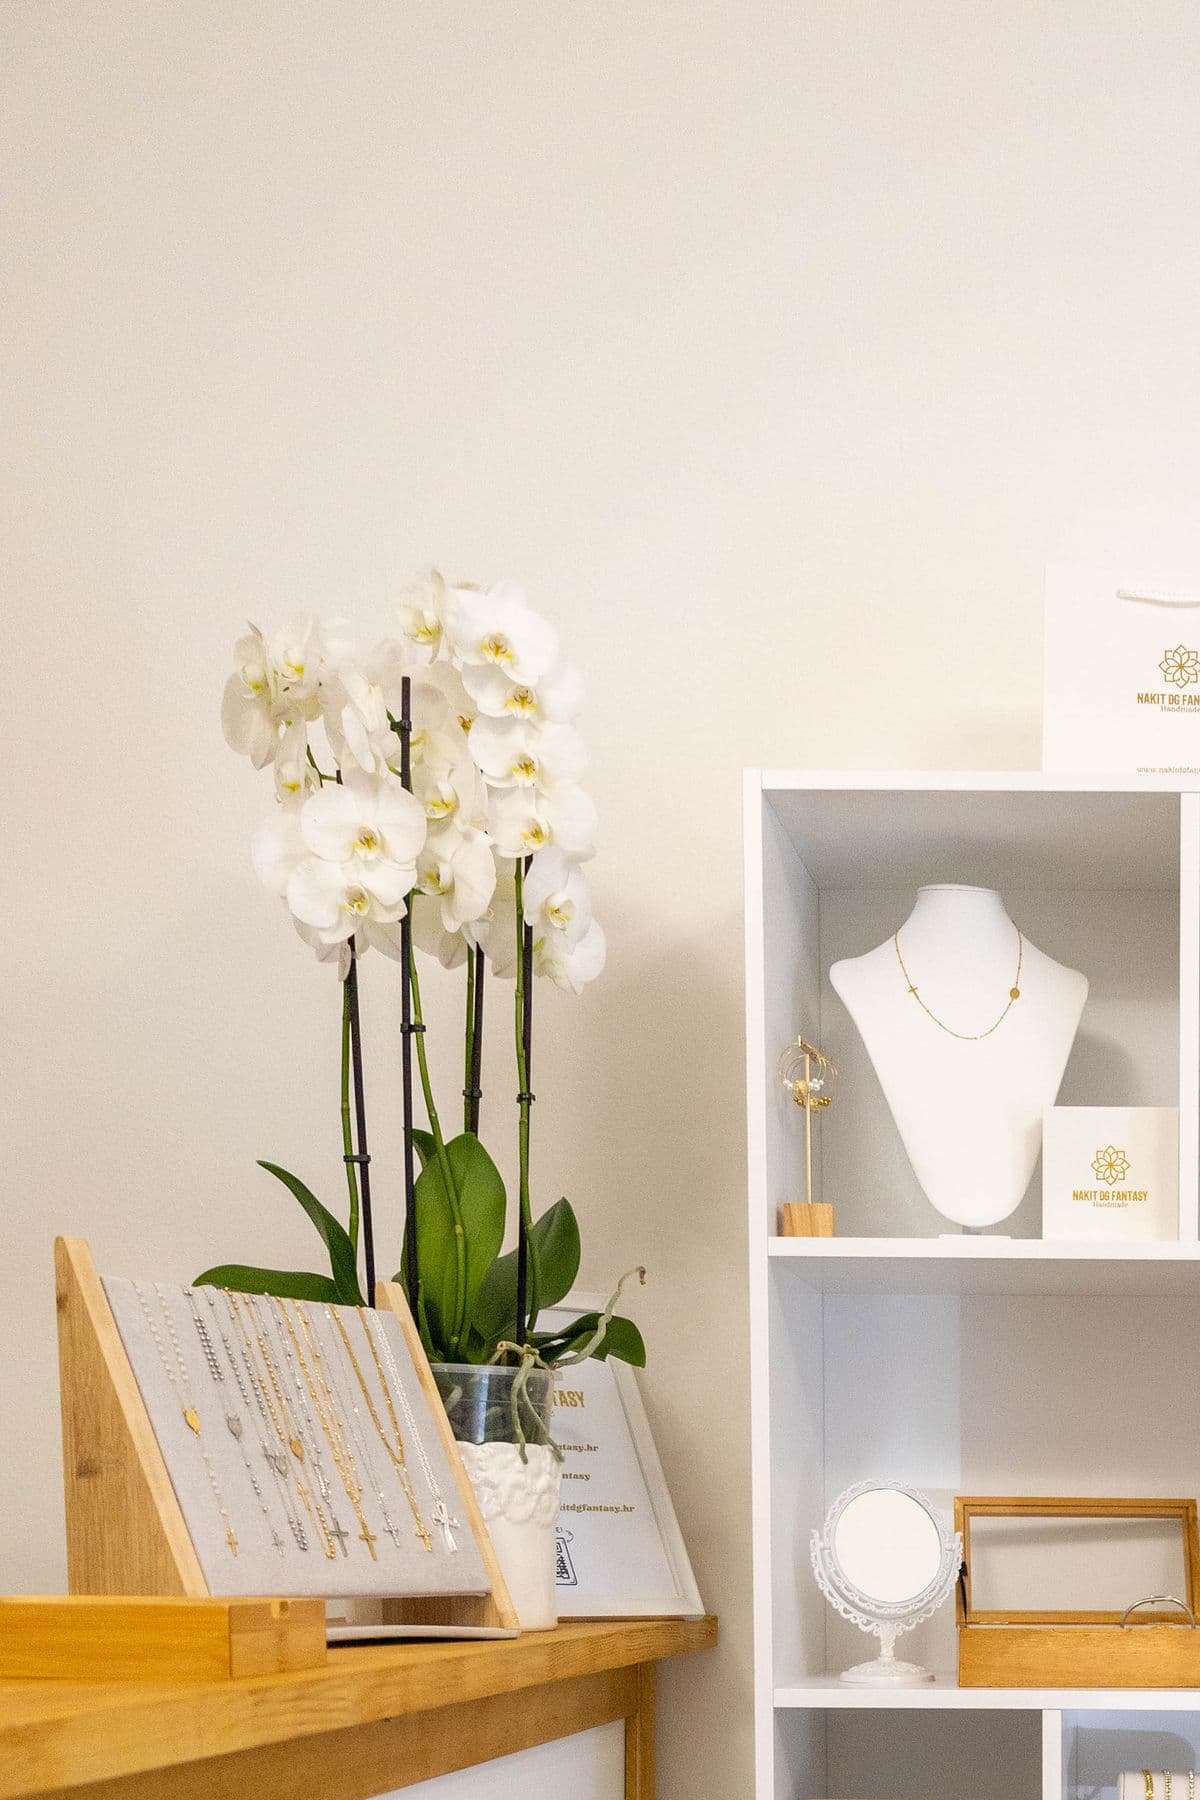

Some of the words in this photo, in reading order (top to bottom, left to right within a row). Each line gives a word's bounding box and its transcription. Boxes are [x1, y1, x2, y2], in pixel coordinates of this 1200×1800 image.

[1137, 693, 1166, 705] NAKIT
[1168, 694, 1180, 705] DG
[1160, 705, 1200, 713] Handmade
[1072, 1190, 1098, 1201] NAKIT
[1099, 1190, 1110, 1201] DG
[1111, 1190, 1148, 1202] FANTASY
[552, 1390, 585, 1408] TASY
